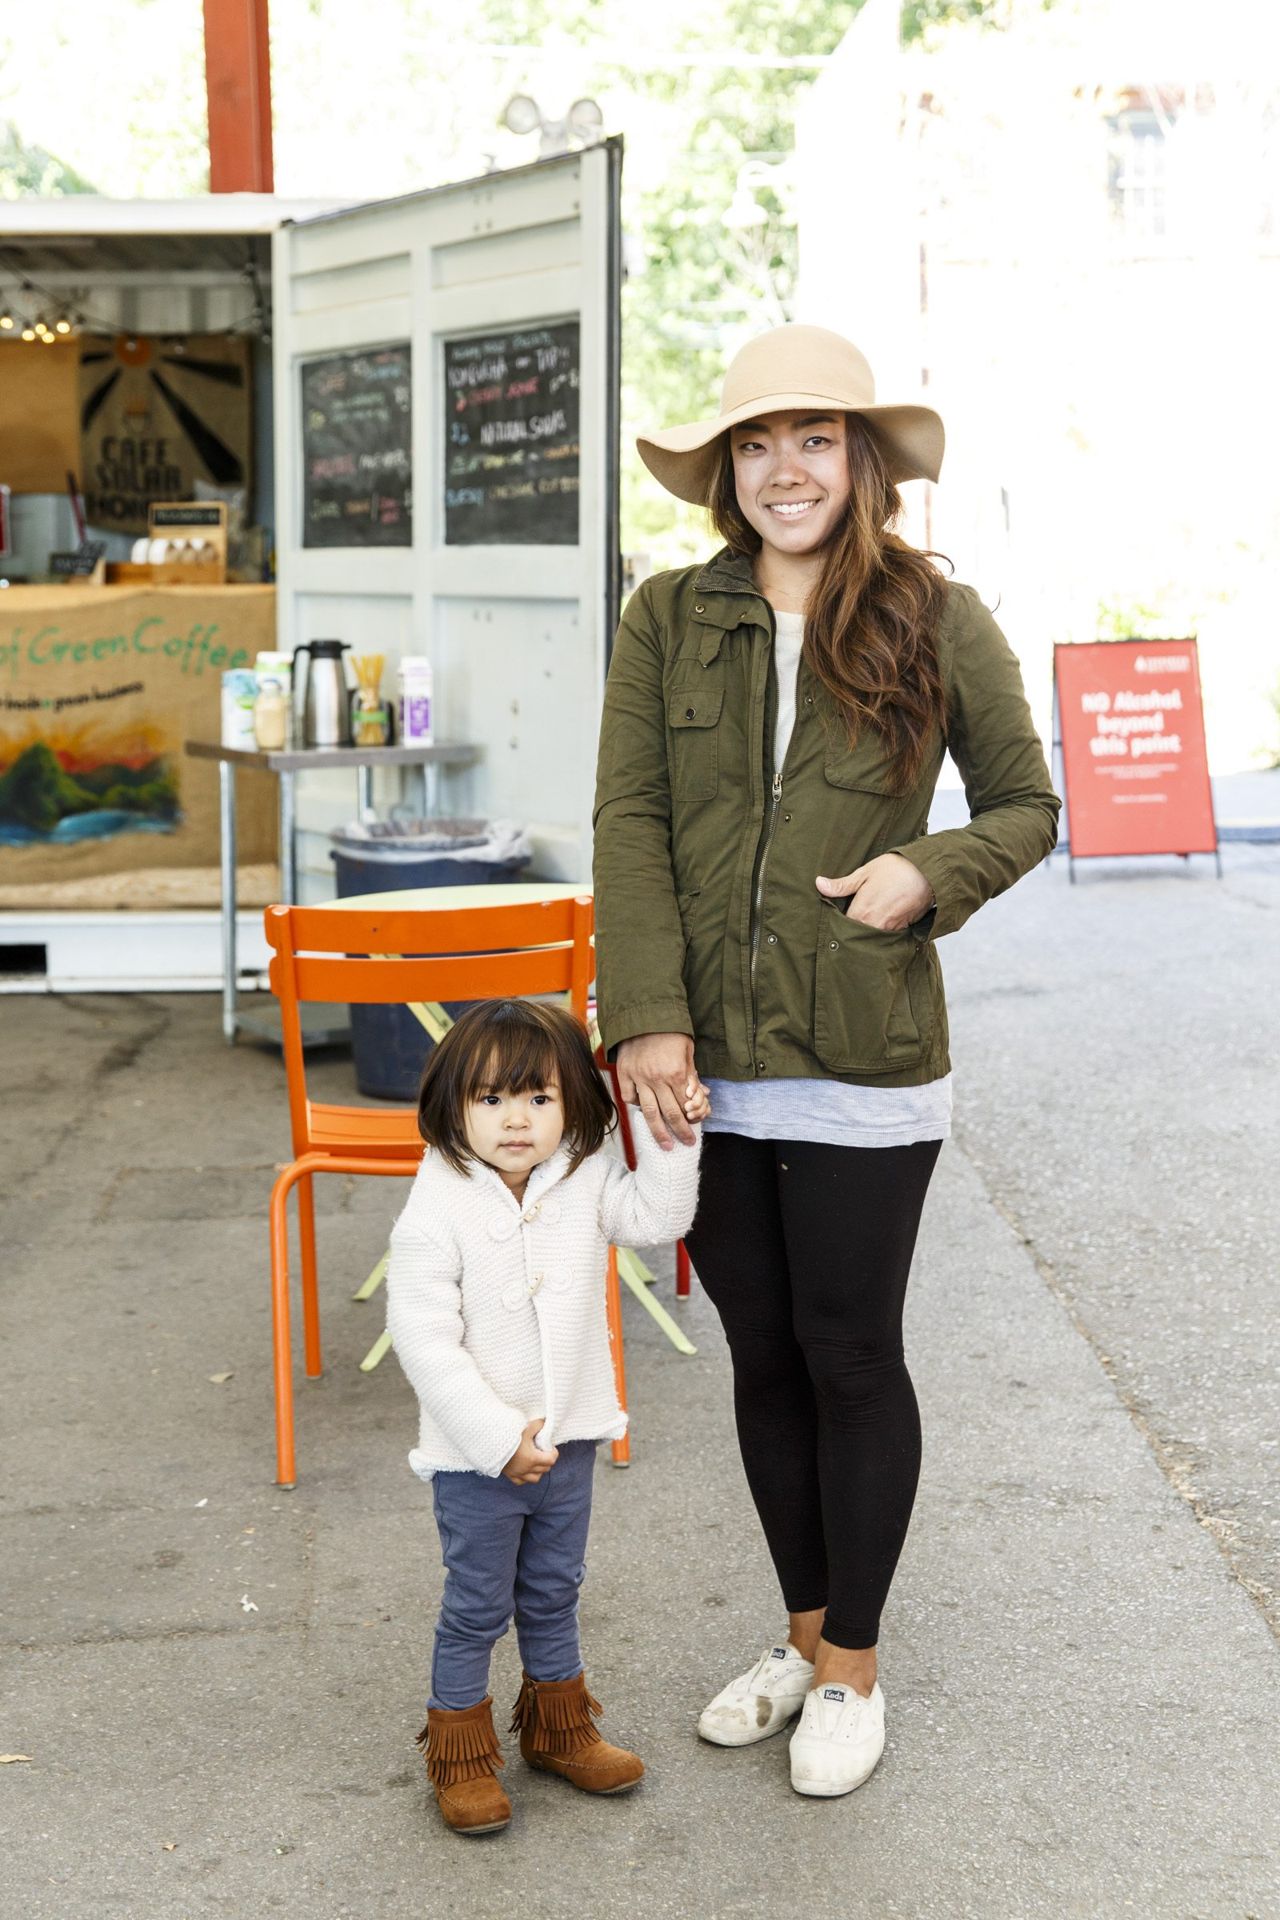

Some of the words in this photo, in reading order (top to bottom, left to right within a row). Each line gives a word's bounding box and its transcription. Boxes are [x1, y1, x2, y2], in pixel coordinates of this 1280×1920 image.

[28, 626, 128, 664] Green
[132, 616, 248, 676] Coffee
[1081, 692, 1111, 713] NO
[1114, 689, 1183, 711] Alcohol
[1096, 712, 1165, 737] beyond
[1089, 735, 1128, 757] this
[825, 1691, 843, 1701] Keds
